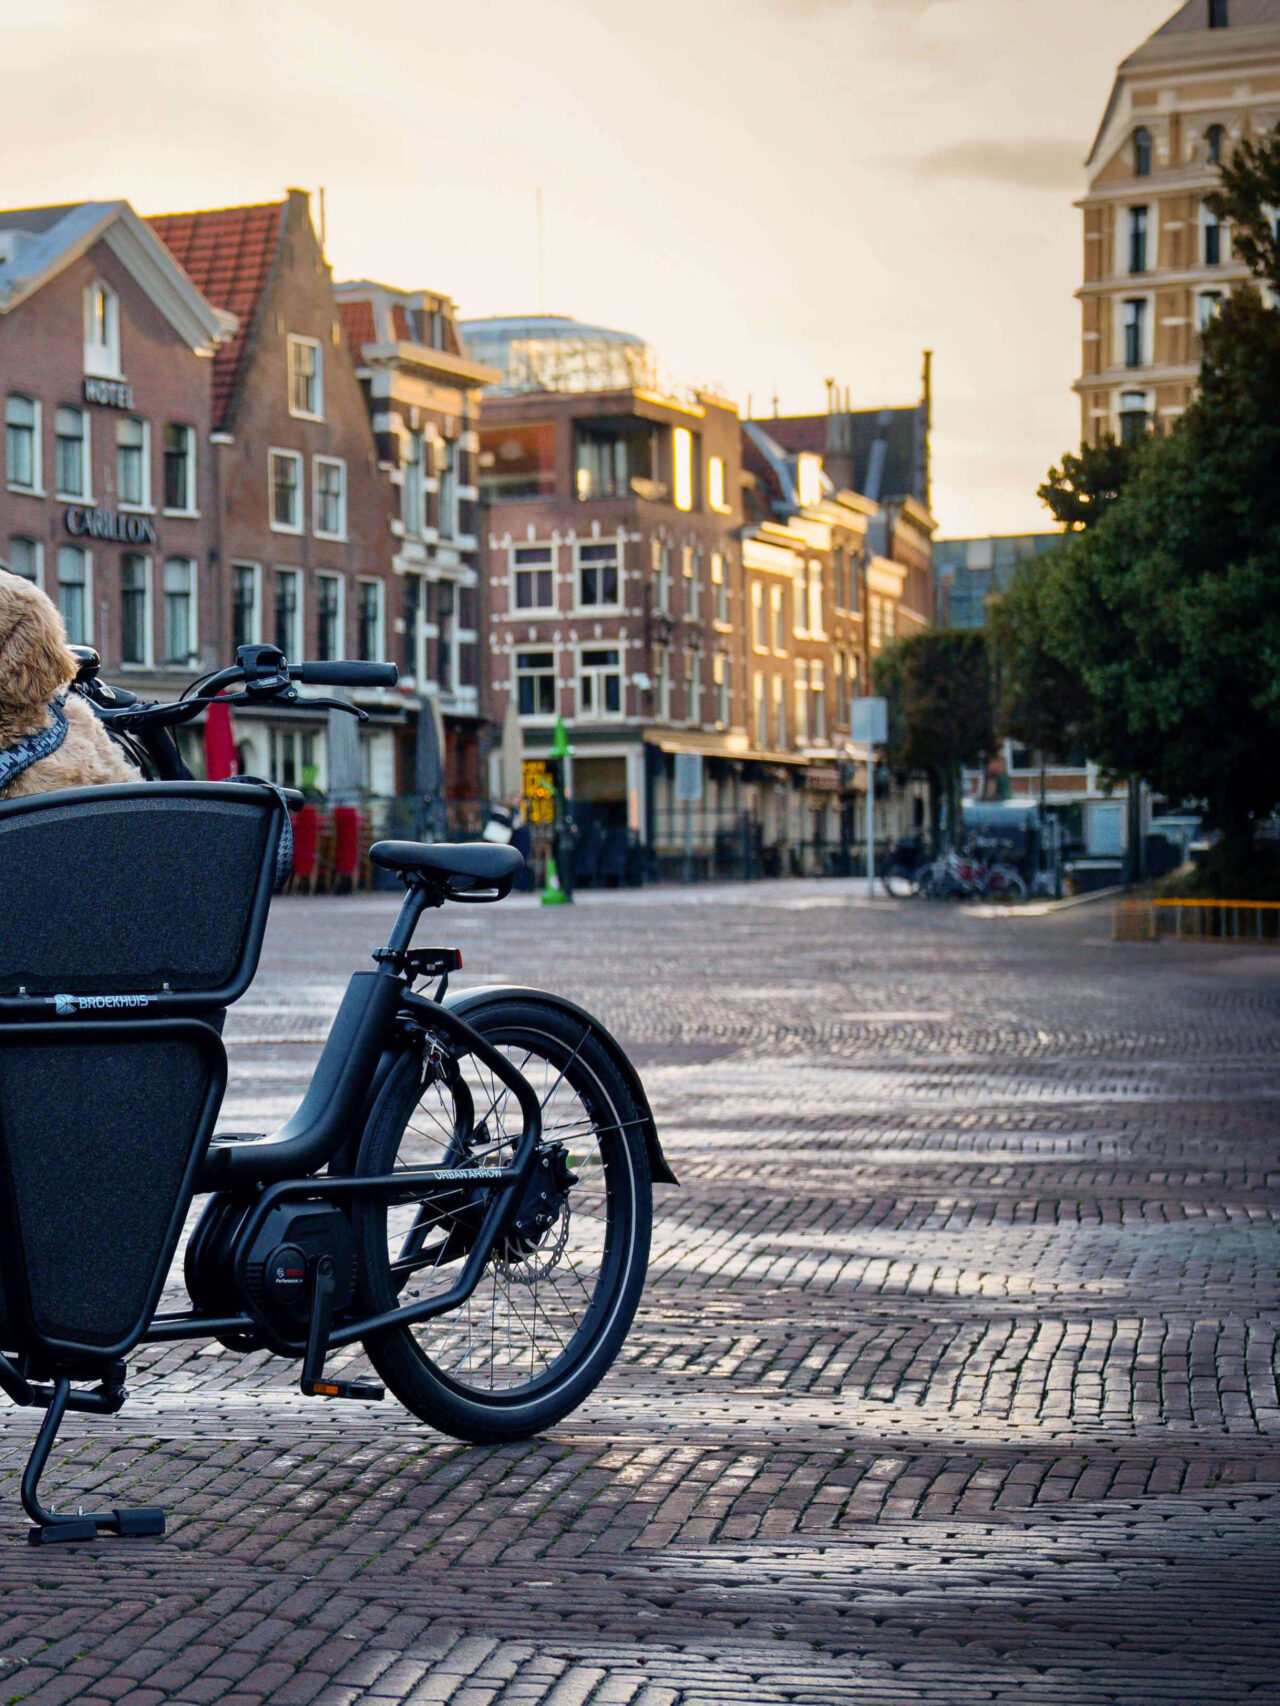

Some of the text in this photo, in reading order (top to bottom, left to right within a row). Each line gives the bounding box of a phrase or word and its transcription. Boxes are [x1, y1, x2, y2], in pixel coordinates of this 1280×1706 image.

[82, 378, 135, 410] HOTEL
[66, 505, 159, 544] CARILLON
[79, 995, 149, 1009] BROEKHUIS
[433, 1168, 502, 1180] URBAN ARROW
